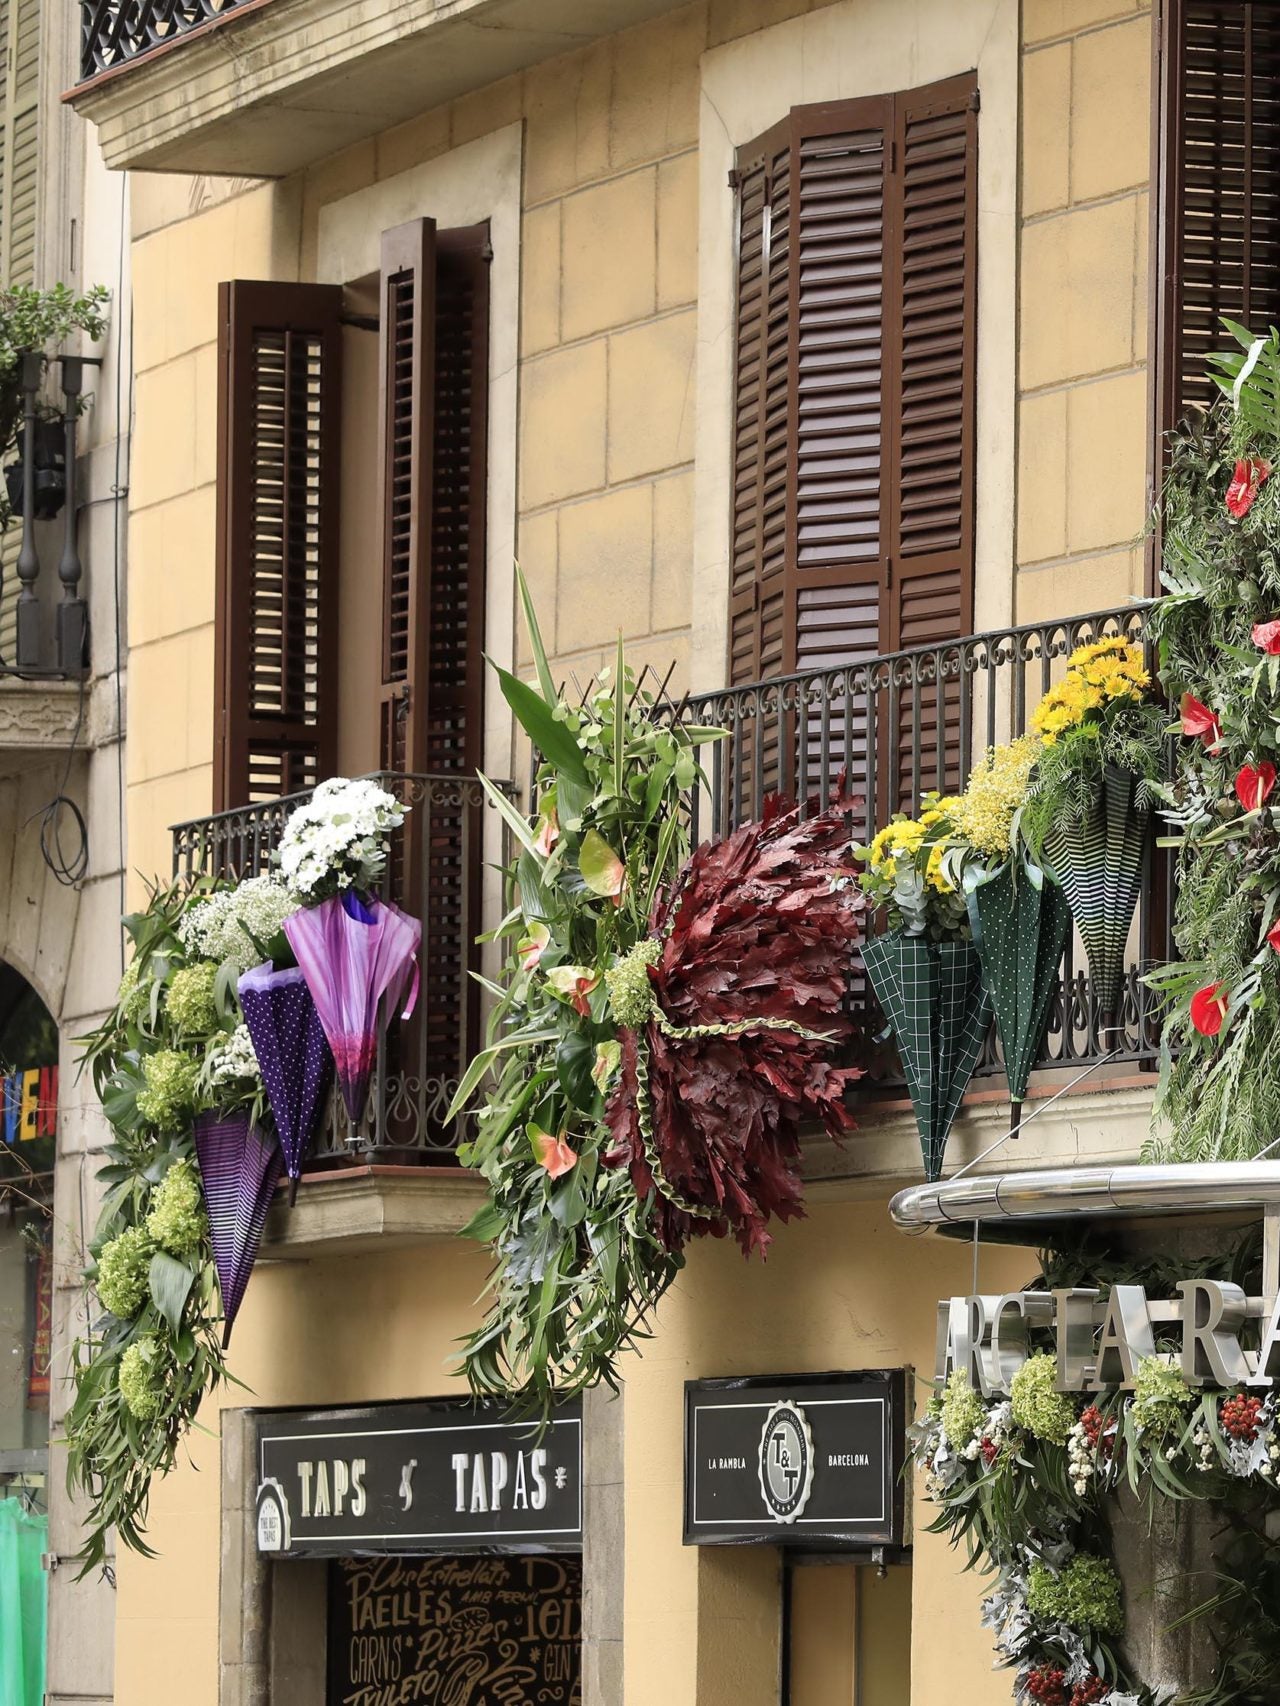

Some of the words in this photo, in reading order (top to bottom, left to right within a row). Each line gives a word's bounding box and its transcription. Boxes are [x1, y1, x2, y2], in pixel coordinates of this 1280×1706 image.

[0, 1065, 59, 1144] VEN
[943, 1292, 1026, 1399] ARC
[1051, 1284, 1141, 1391] LA
[708, 1458, 717, 1469] LA
[719, 1457, 746, 1469] RAMBLA
[828, 1454, 869, 1467] BARCELONA
[297, 1458, 367, 1518] TAPS
[350, 1635, 403, 1687] CARNS
[543, 1643, 571, 1682] GIN
